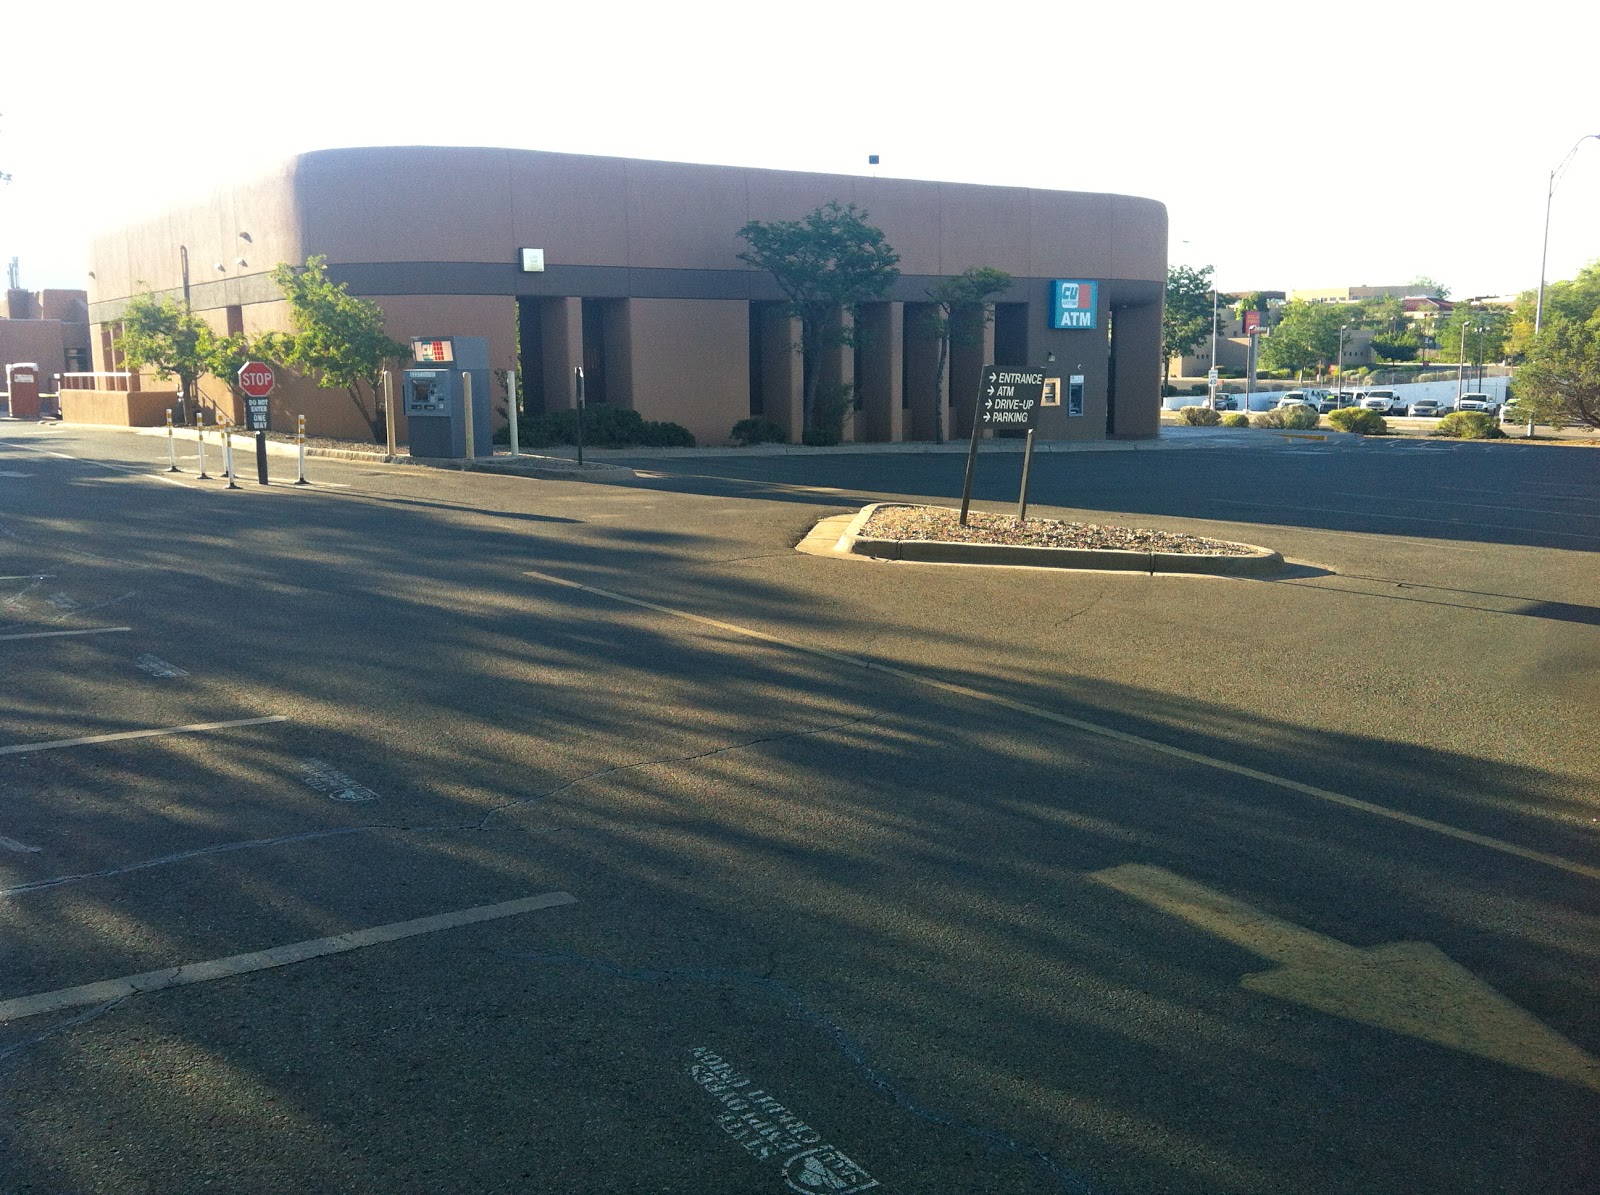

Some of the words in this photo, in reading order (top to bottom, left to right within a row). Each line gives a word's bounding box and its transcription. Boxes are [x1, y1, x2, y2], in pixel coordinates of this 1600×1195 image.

[1060, 312, 1091, 326] ATM
[242, 372, 272, 386] STOP
[998, 372, 1043, 385] ENTRANCE
[996, 386, 1015, 397] ATM
[994, 398, 1035, 410] DRIVE-UP
[992, 411, 1029, 423] PARKING
[748, 1090, 821, 1144] CREDIT
